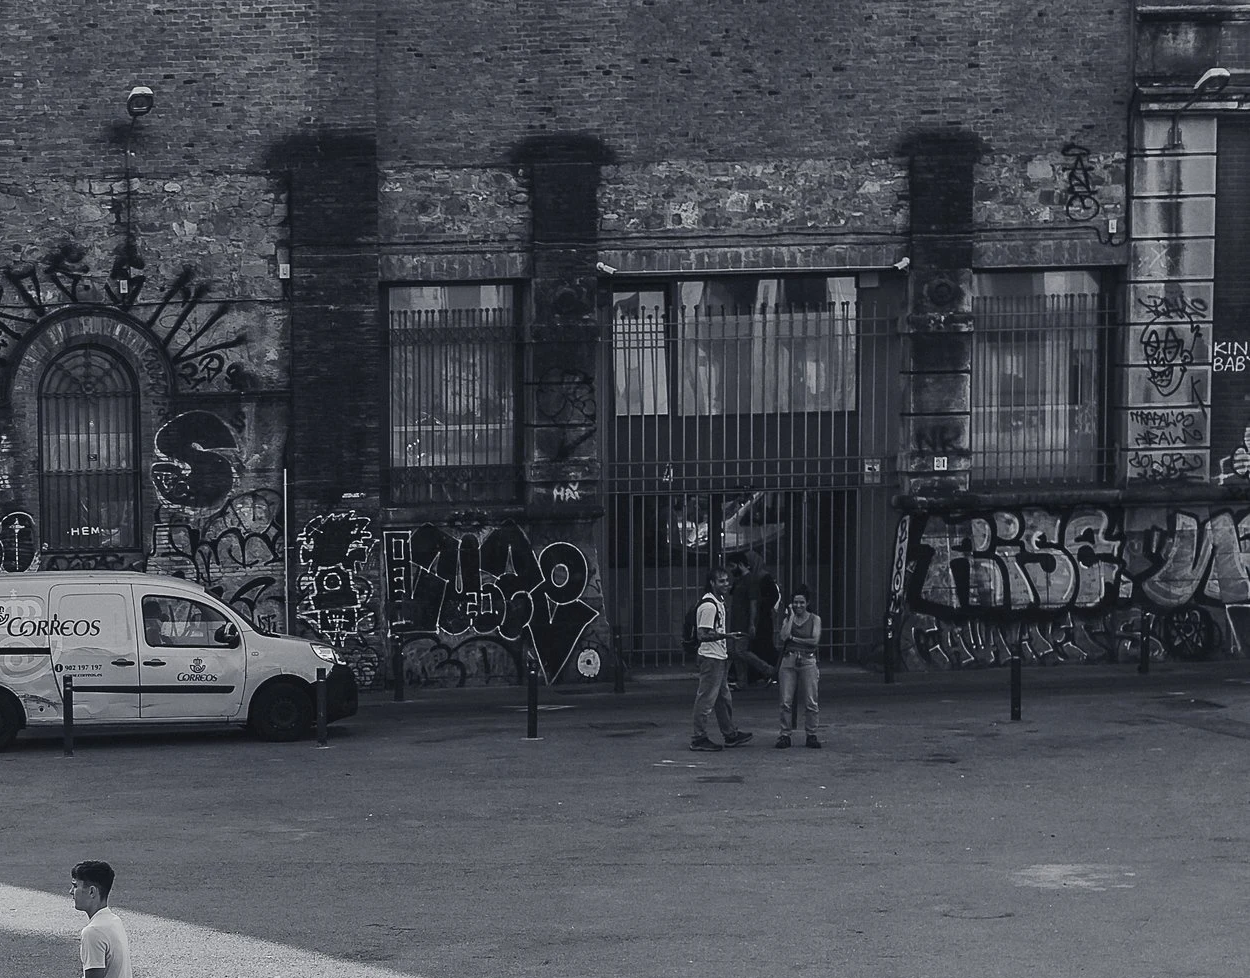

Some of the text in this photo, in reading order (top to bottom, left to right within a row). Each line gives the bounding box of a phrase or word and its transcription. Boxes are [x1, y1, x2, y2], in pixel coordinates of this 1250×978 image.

[1213, 356, 1250, 372] BAB
[7, 617, 101, 637] CORREOS
[177, 672, 218, 682] CORREOS
